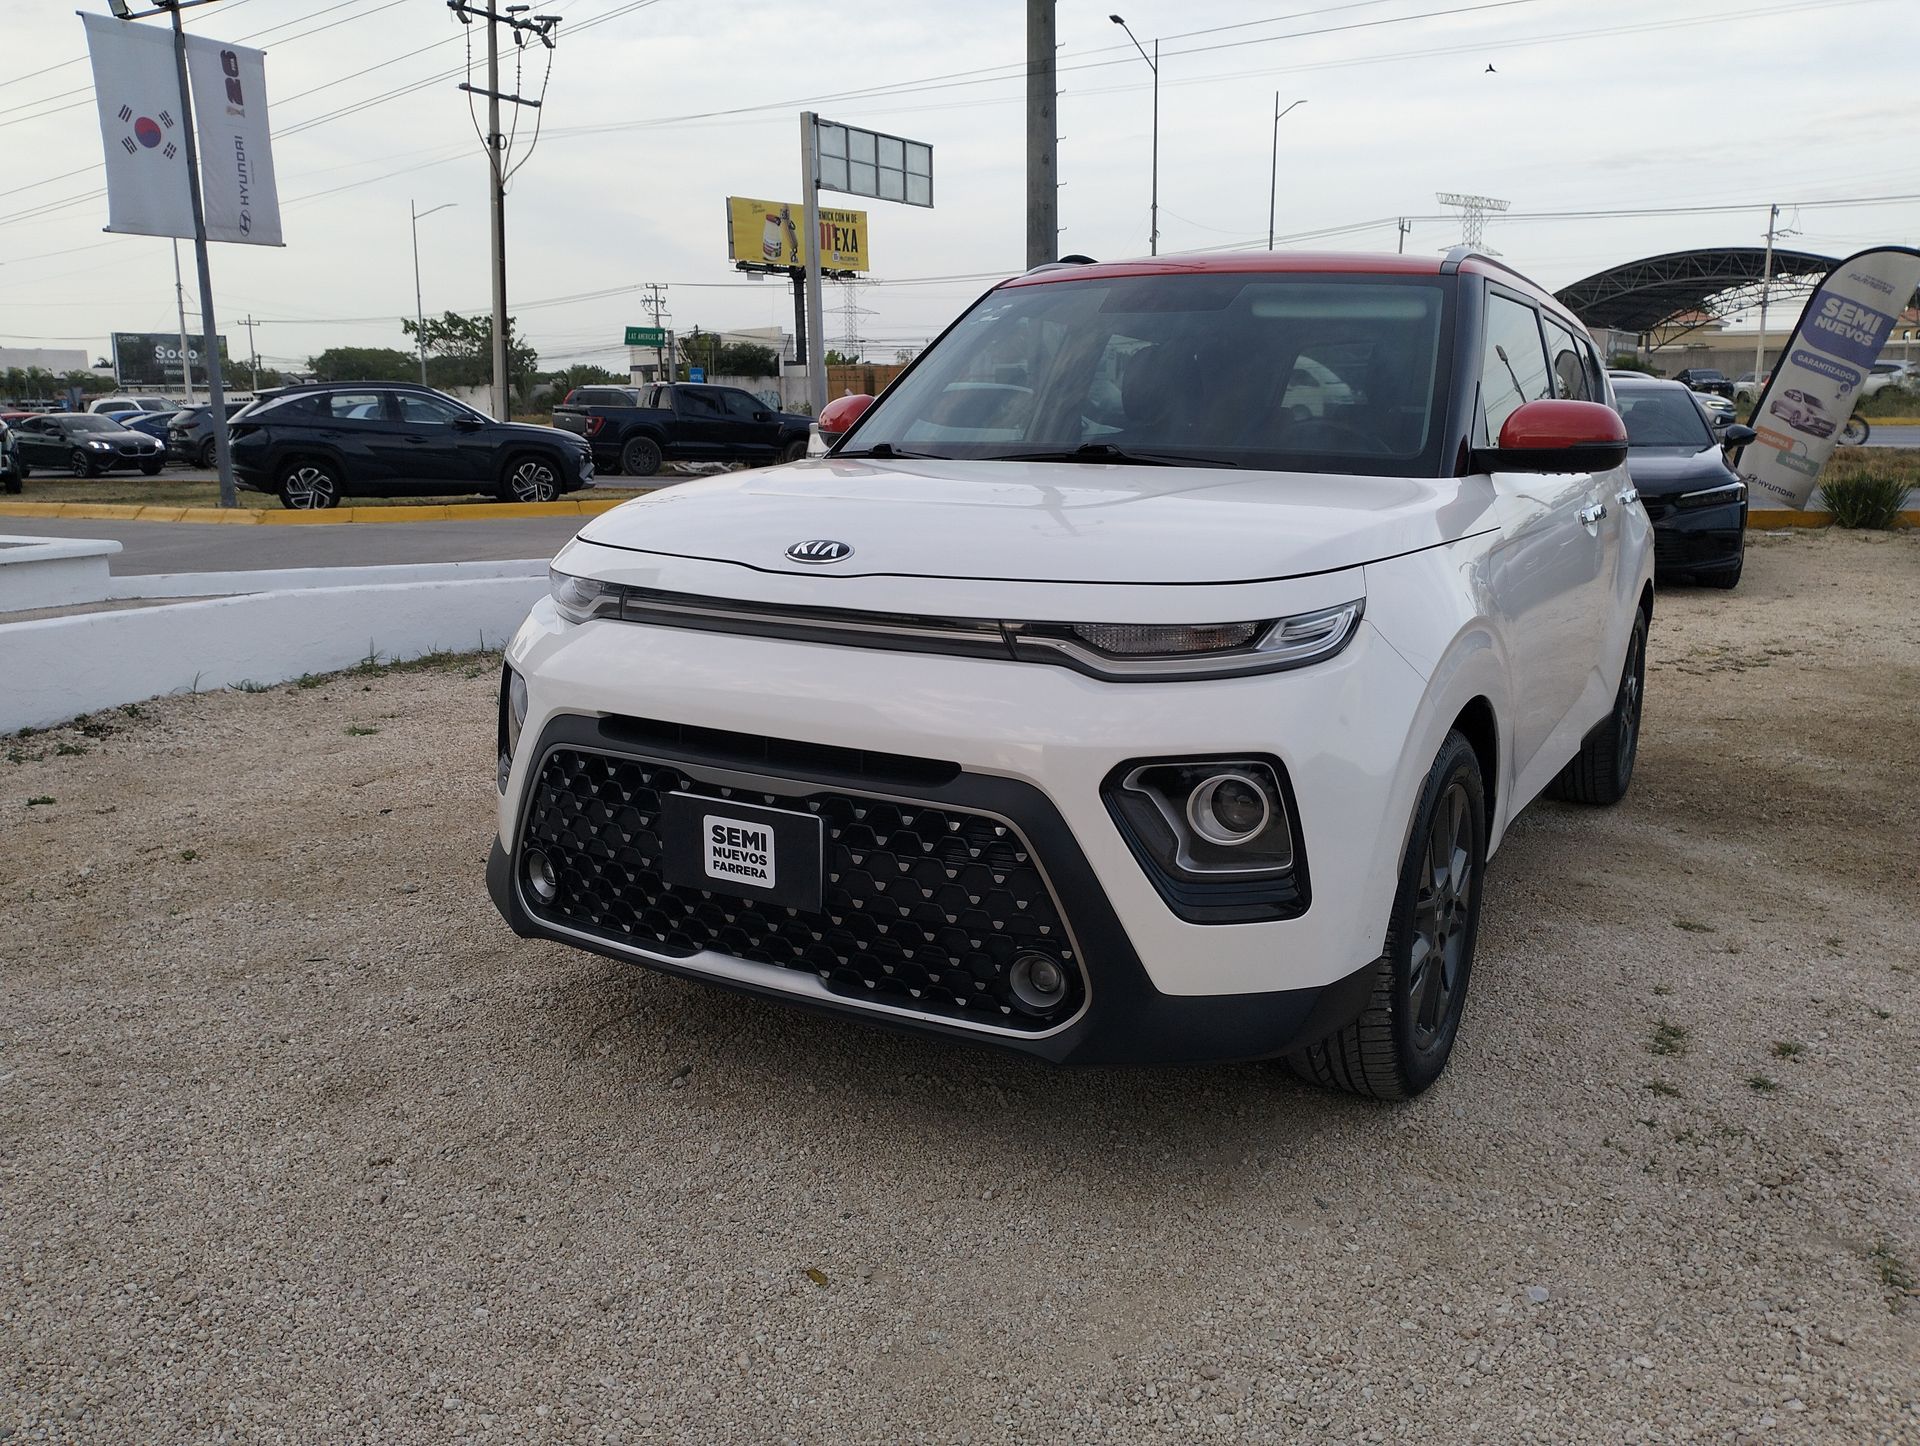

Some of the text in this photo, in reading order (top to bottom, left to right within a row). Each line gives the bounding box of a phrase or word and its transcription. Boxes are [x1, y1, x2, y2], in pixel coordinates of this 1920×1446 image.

[234, 135, 249, 206] HYUNDAI
[1821, 298, 1883, 335] SEMI
[1814, 315, 1875, 347] NUEVOS
[1797, 354, 1857, 382] GARANTIZADOS
[1758, 479, 1797, 500] HYUNDAI
[793, 541, 840, 557] KIA
[711, 824, 767, 852] SEMI
[712, 846, 768, 866] NUEVOS
[713, 860, 768, 880] FARRERA
